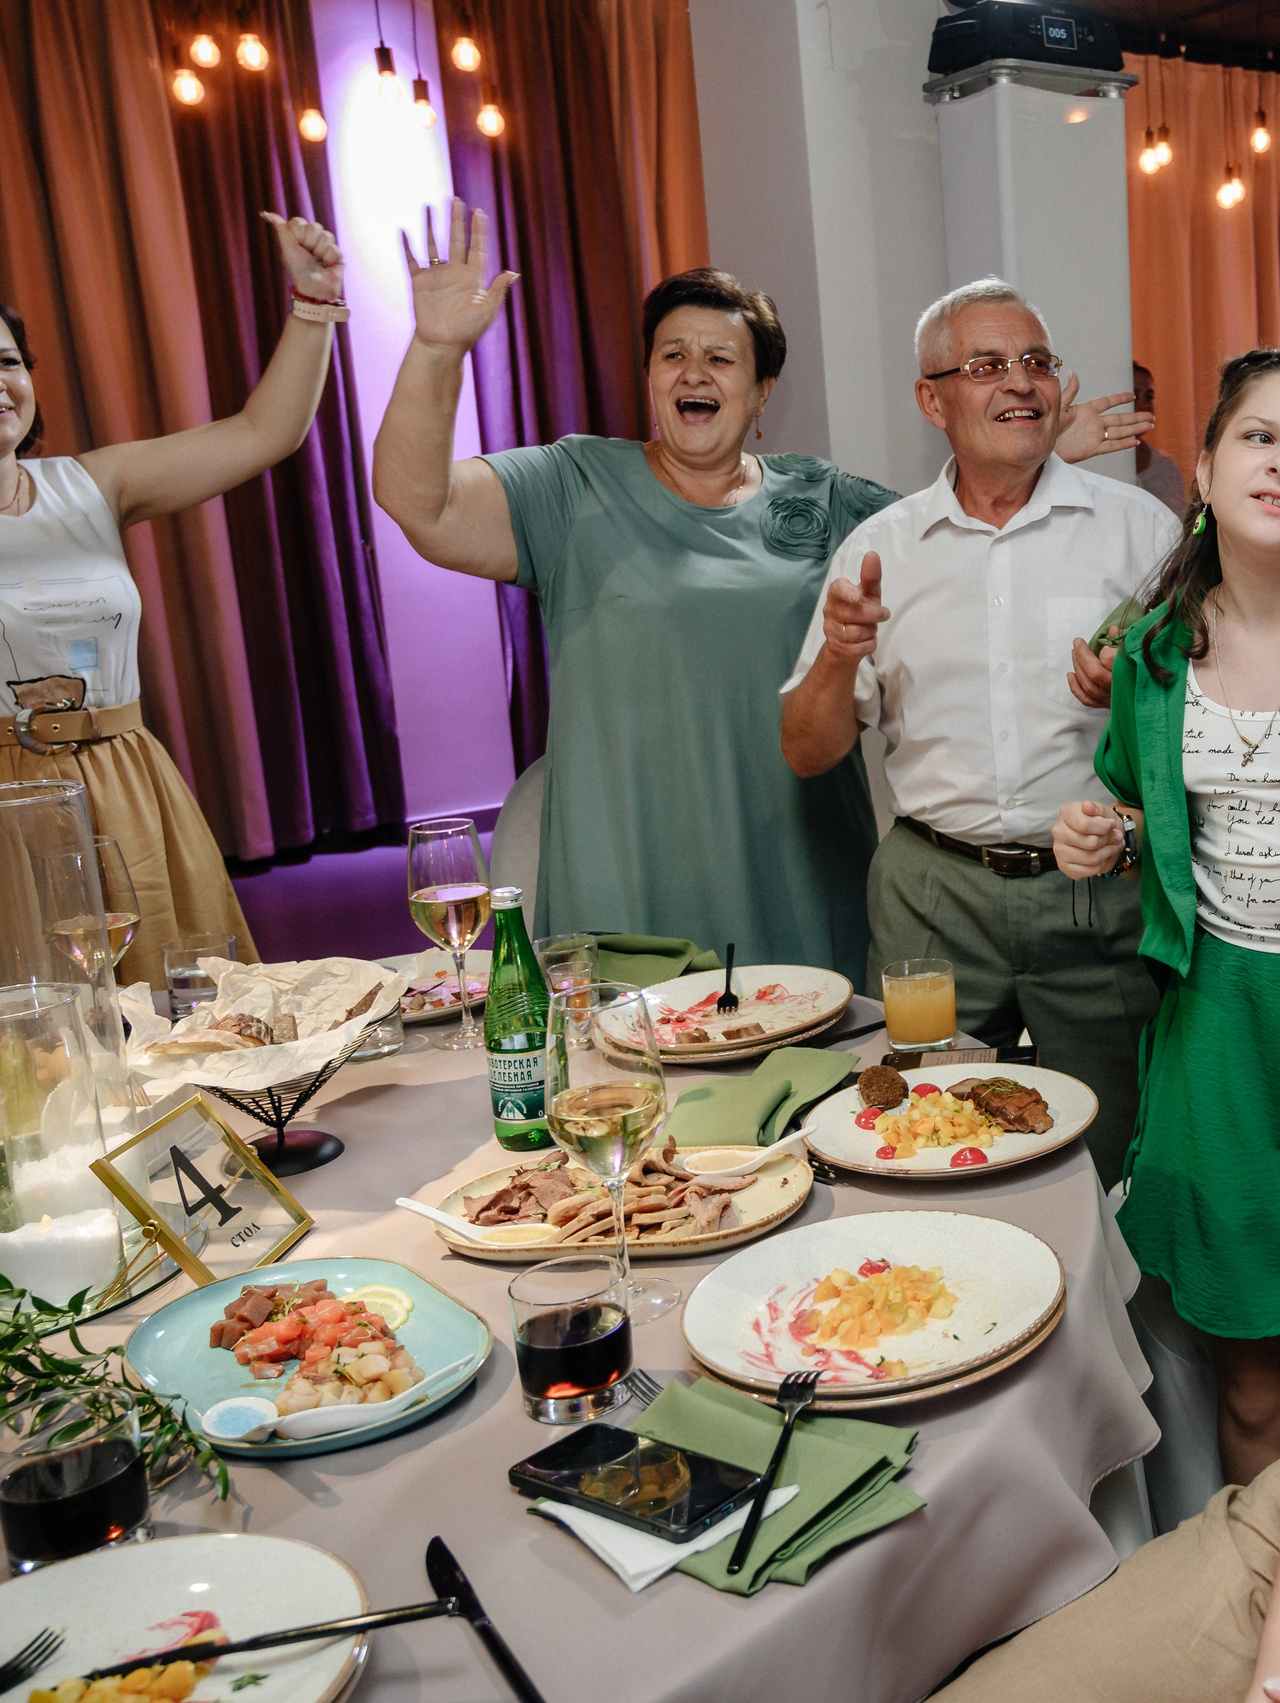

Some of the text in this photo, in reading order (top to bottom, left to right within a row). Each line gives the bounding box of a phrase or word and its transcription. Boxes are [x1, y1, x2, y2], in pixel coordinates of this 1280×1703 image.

[1049, 27, 1067, 39] 005
[1227, 773, 1239, 782] Do
[1228, 800, 1250, 811] could
[1227, 812, 1250, 833] You
[1257, 816, 1274, 825] did
[1247, 873, 1257, 890] of
[1247, 893, 1258, 908] for
[487, 1056, 539, 1070] ОВОТЕРСКАЯ
[169, 1144, 243, 1227] 4
[230, 1222, 262, 1248] СТОЛ
